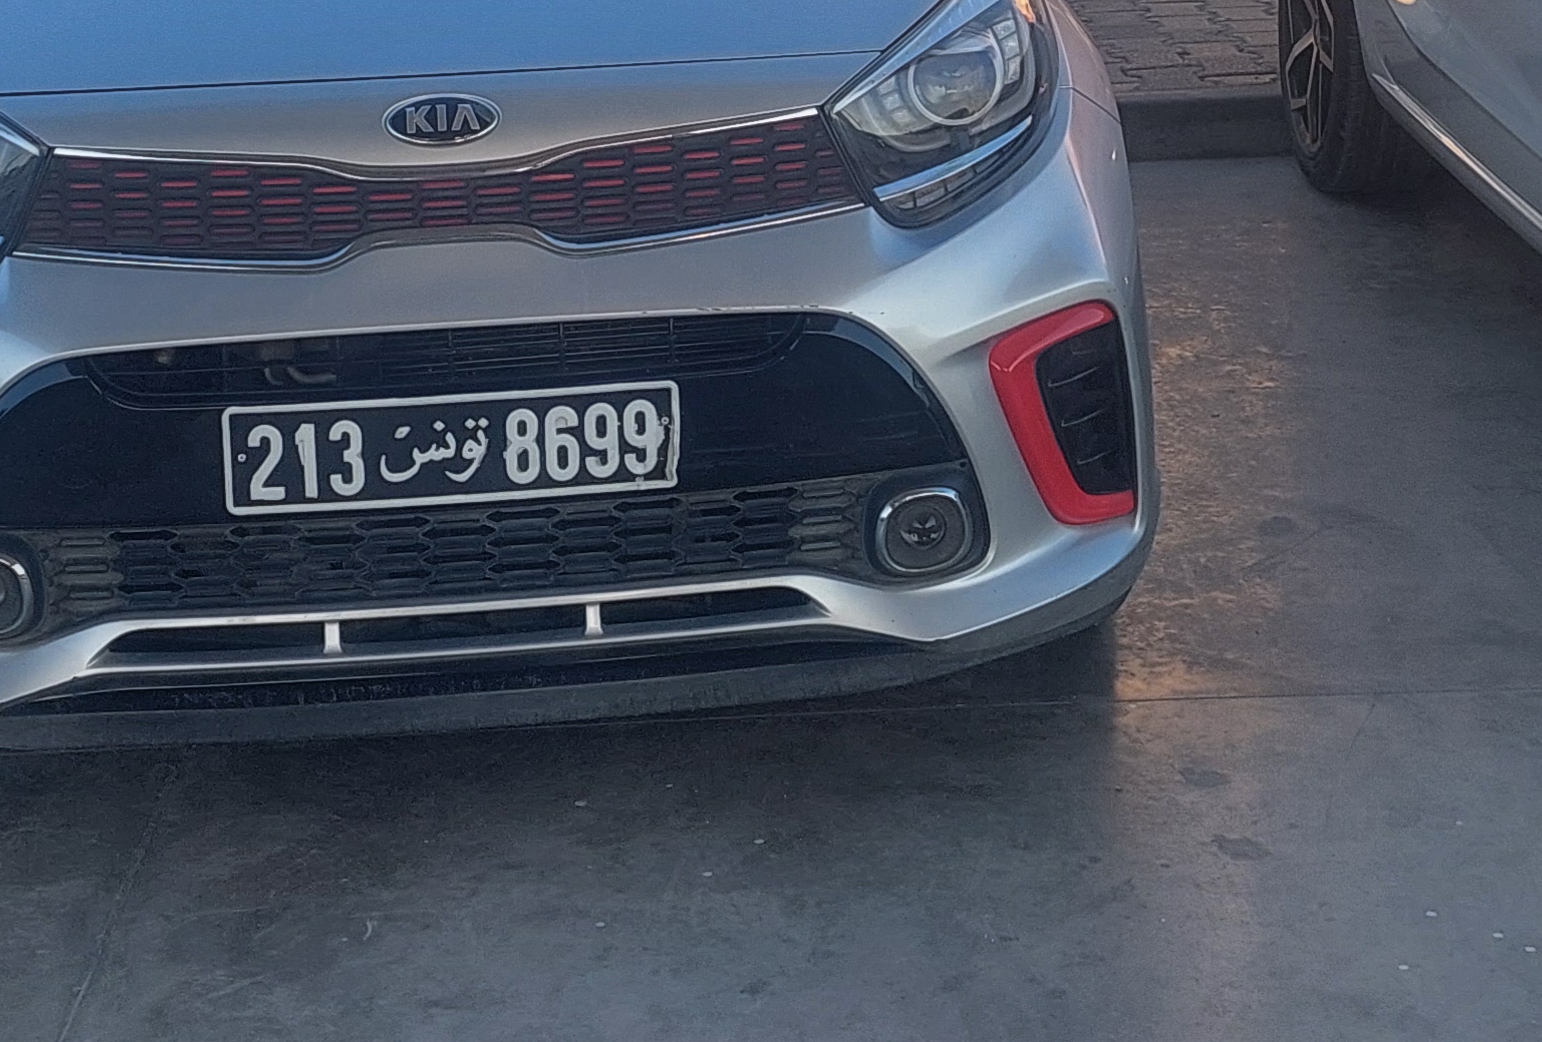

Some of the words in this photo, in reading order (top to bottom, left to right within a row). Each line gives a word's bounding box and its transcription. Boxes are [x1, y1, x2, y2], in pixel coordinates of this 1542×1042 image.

[405, 102, 482, 135] KIA
[248, 419, 366, 502] 213
[379, 417, 492, 484] تونس
[504, 398, 659, 486] 8699
